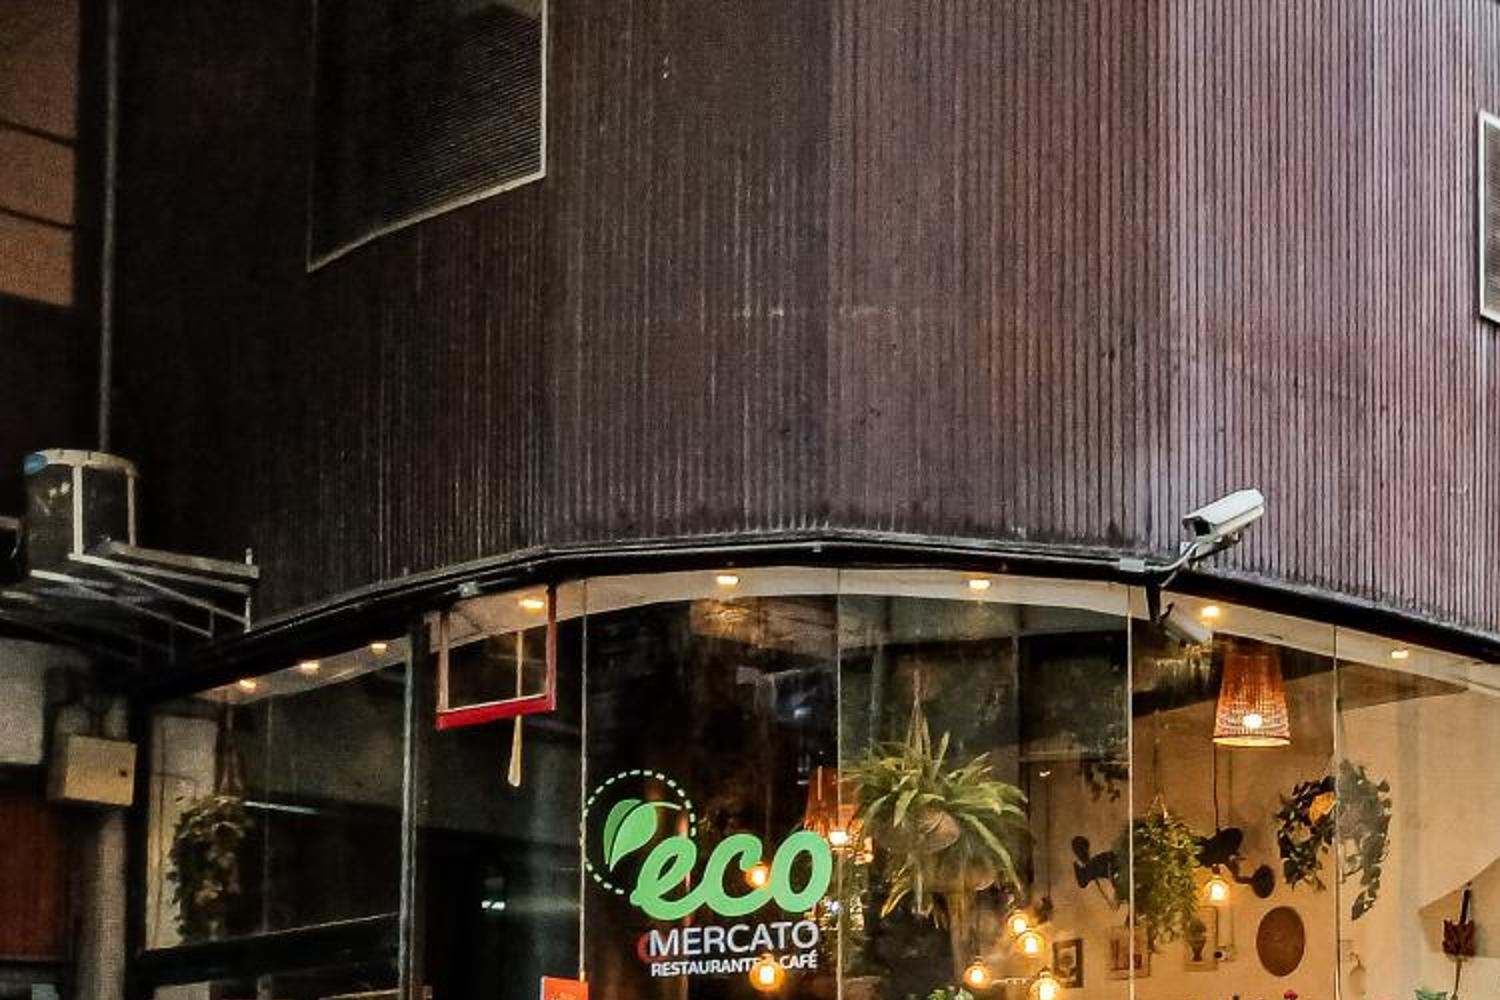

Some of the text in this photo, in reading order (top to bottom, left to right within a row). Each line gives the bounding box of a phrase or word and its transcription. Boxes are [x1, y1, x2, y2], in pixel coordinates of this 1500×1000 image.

[630, 831, 833, 921] eco
[650, 921, 819, 957] MERCATO
[780, 950, 818, 969] CAFÉ
